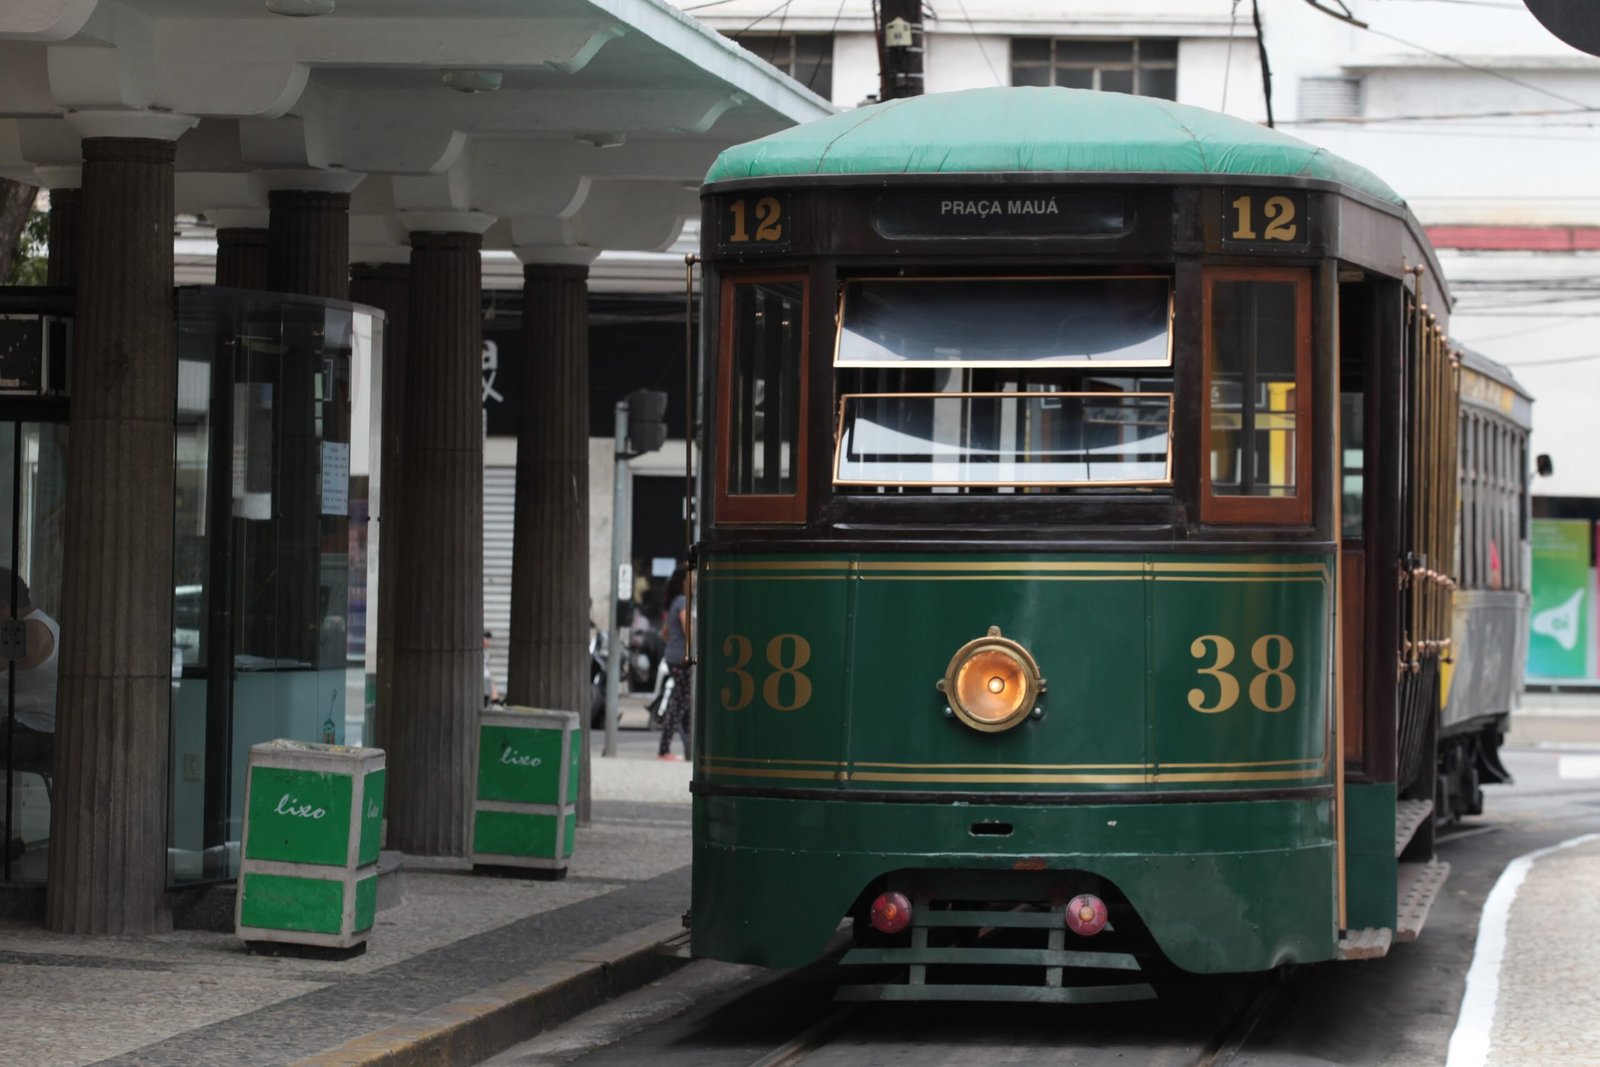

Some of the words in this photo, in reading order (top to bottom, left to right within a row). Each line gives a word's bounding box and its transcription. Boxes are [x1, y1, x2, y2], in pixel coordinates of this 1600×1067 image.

[730, 196, 782, 242] 12
[941, 200, 1002, 219] PRAÇA
[1007, 196, 1059, 215] MAUÁ
[1232, 195, 1297, 241] 12
[720, 633, 813, 711] 38
[1187, 634, 1296, 713] 38
[499, 746, 542, 767] lixo
[273, 793, 327, 819] lixo
